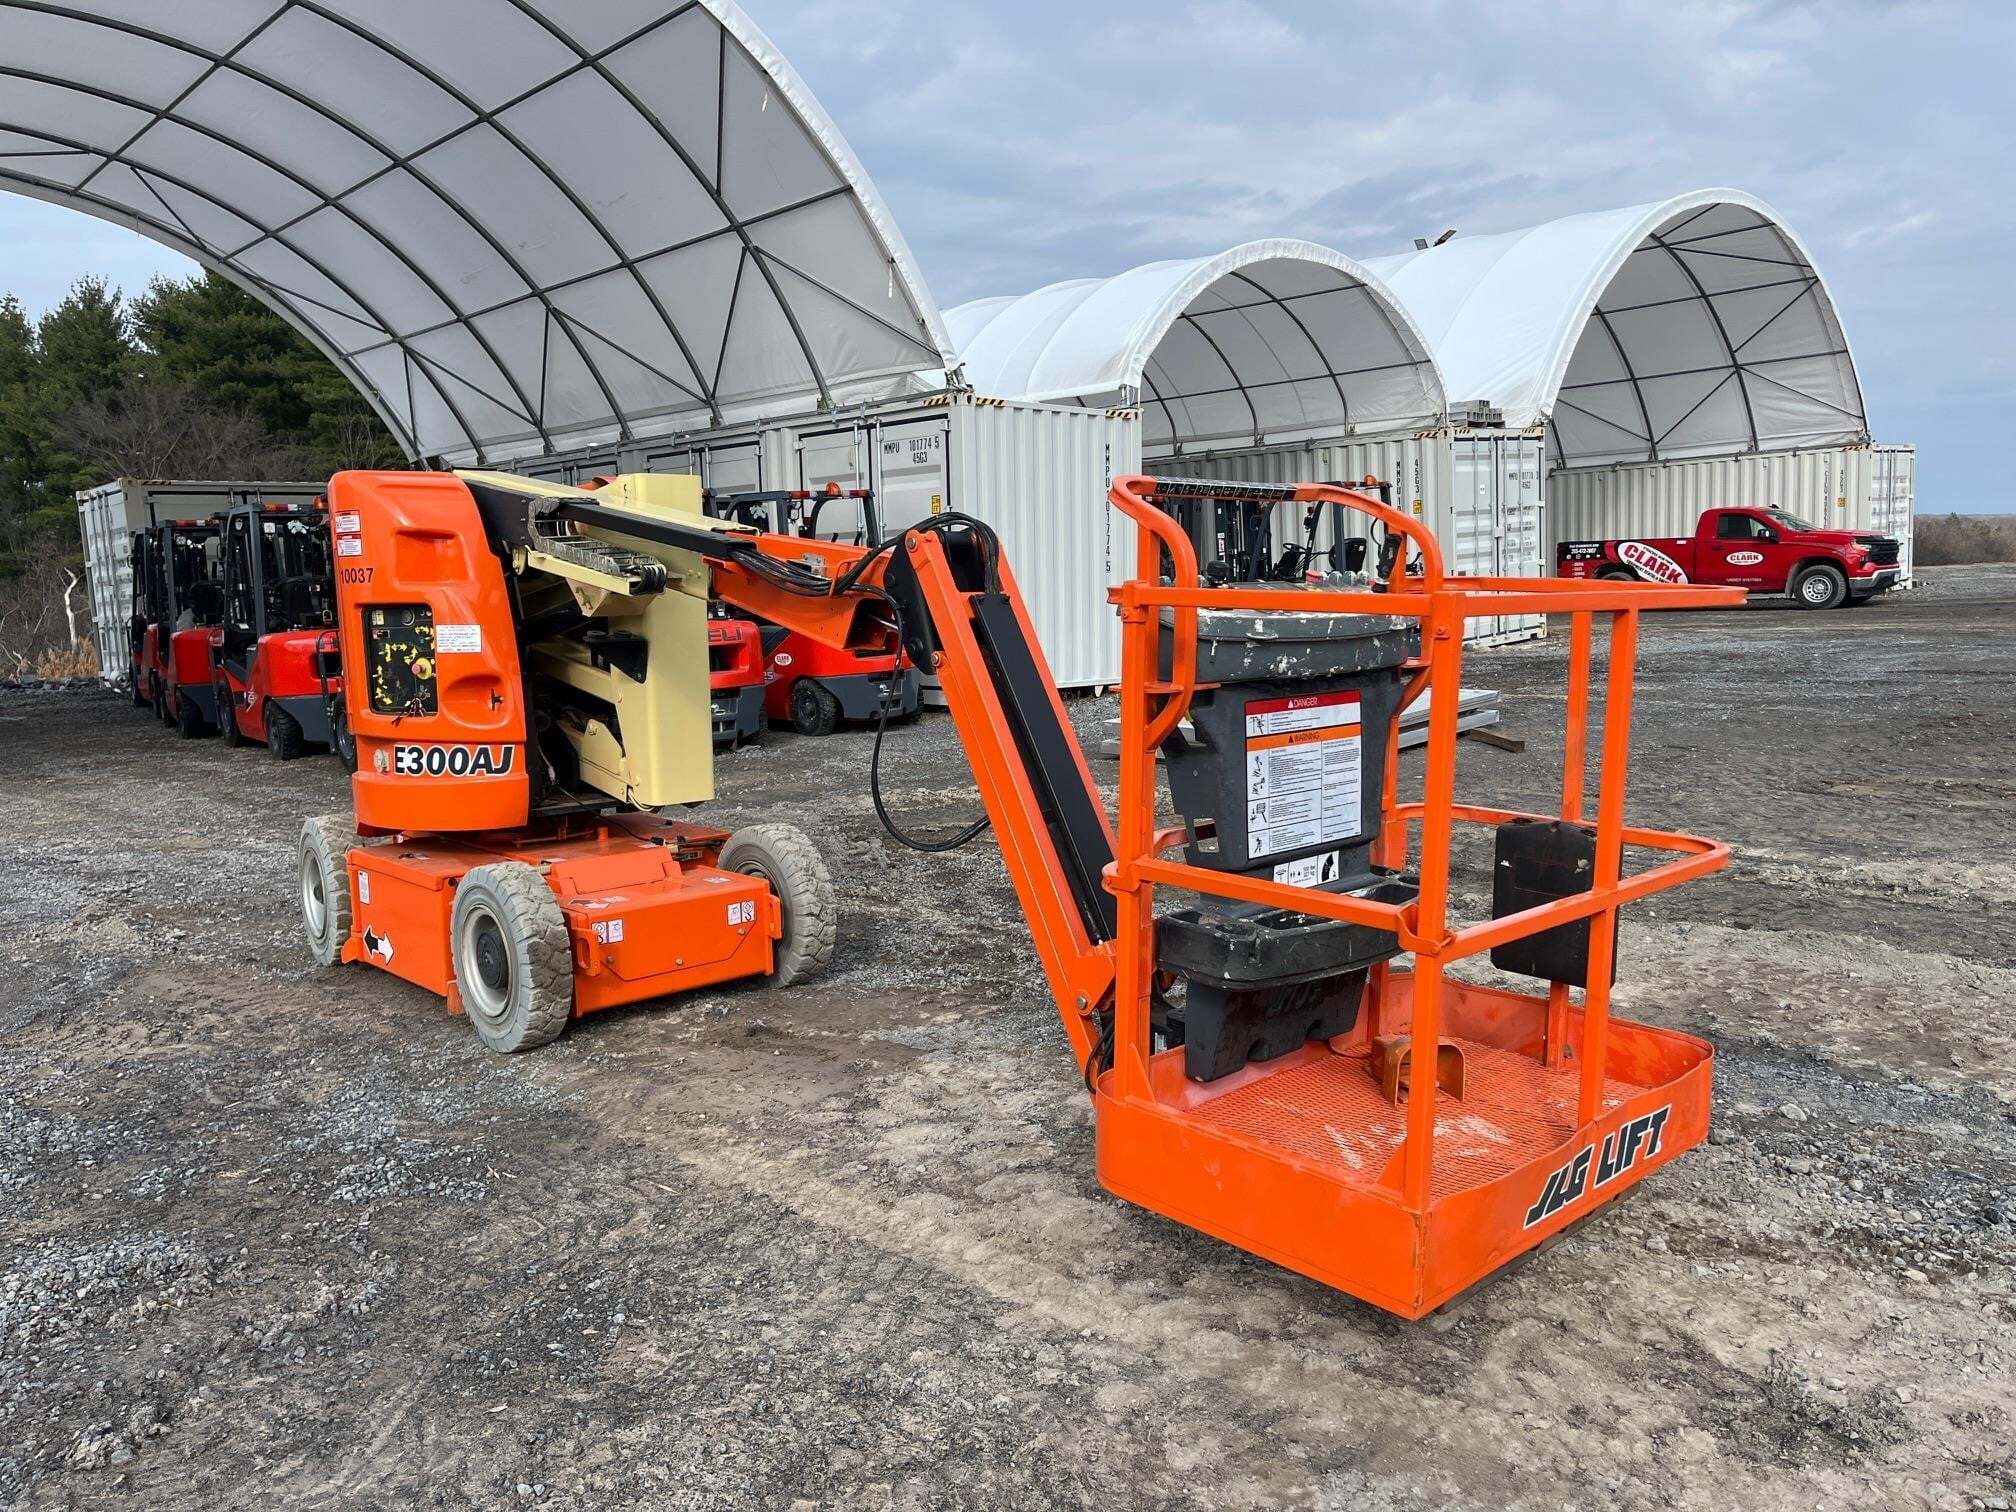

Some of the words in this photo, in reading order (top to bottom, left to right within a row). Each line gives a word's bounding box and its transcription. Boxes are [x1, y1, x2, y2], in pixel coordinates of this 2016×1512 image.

[883, 441, 900, 454] MMPU
[909, 437, 932, 452] 101774
[934, 435, 940, 449] 5
[340, 567, 374, 585] 10037
[1623, 544, 1683, 584] CLARK
[1293, 697, 1319, 708] DANGER
[395, 744, 515, 777] E300AJ
[1524, 1145, 1595, 1229] JLG
[1594, 1104, 1672, 1189] LIFT
